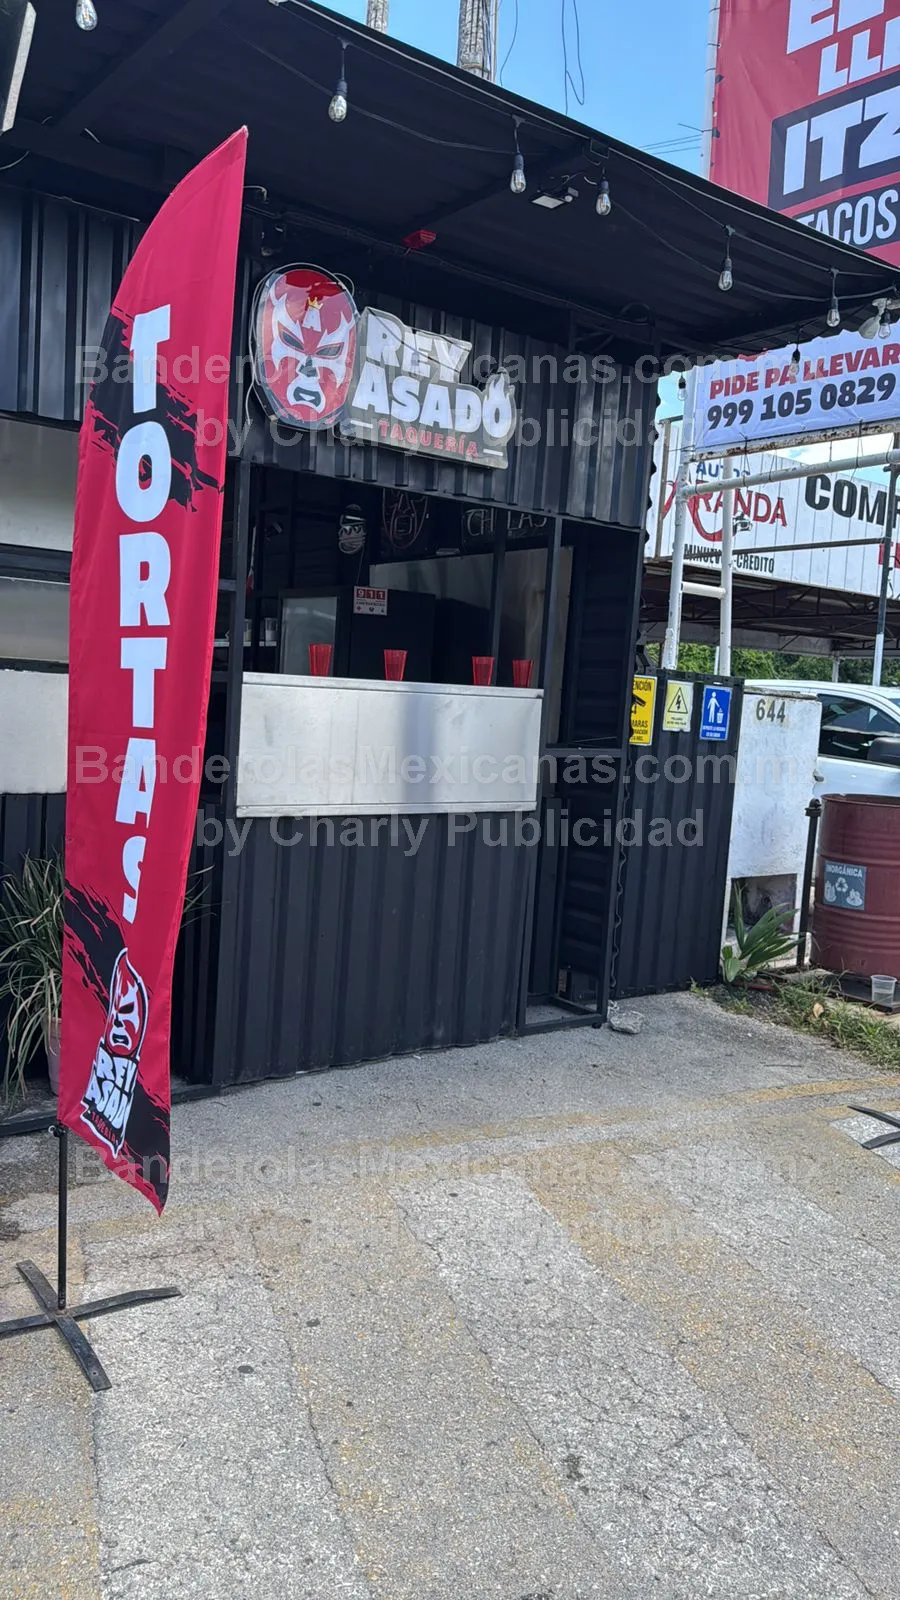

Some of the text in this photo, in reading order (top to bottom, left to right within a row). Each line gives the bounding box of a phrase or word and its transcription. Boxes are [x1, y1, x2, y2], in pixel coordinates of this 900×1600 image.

[365, 313, 465, 382] REY
[709, 343, 900, 400] PIDE PA LLEVAR
[352, 361, 513, 439] ASADO
[707, 372, 896, 430] 999 105 0829
[378, 418, 479, 459] TAQUERÍA
[358, 590, 385, 600] 911
[755, 698, 786, 723] 644
